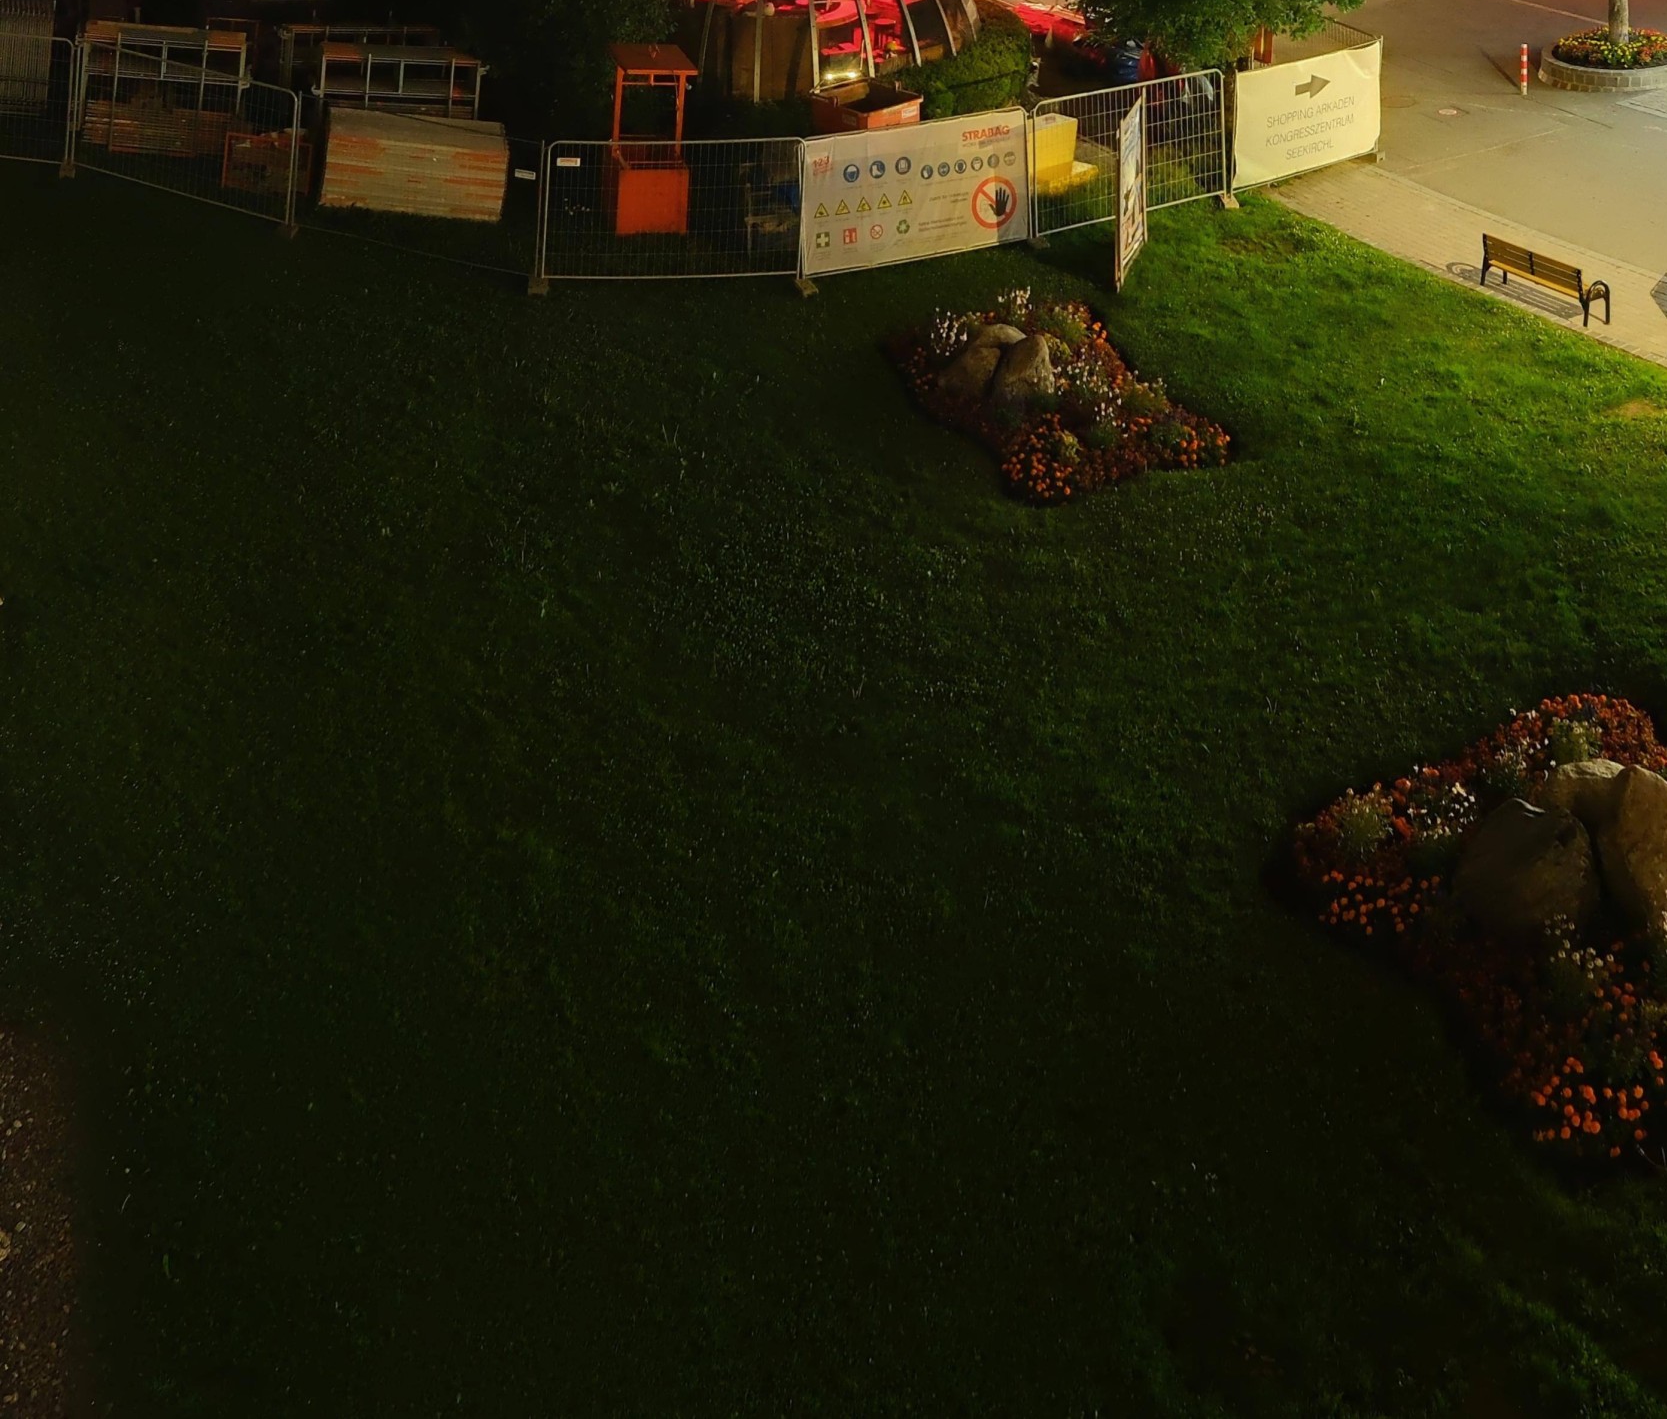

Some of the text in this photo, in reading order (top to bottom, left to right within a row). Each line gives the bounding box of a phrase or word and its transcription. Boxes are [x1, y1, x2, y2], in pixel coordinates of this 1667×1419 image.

[1266, 95, 1356, 129] SHOPPING ARKADEN
[962, 124, 1010, 142] STRABAG
[1265, 113, 1355, 147] KONGRESSZENTRUM
